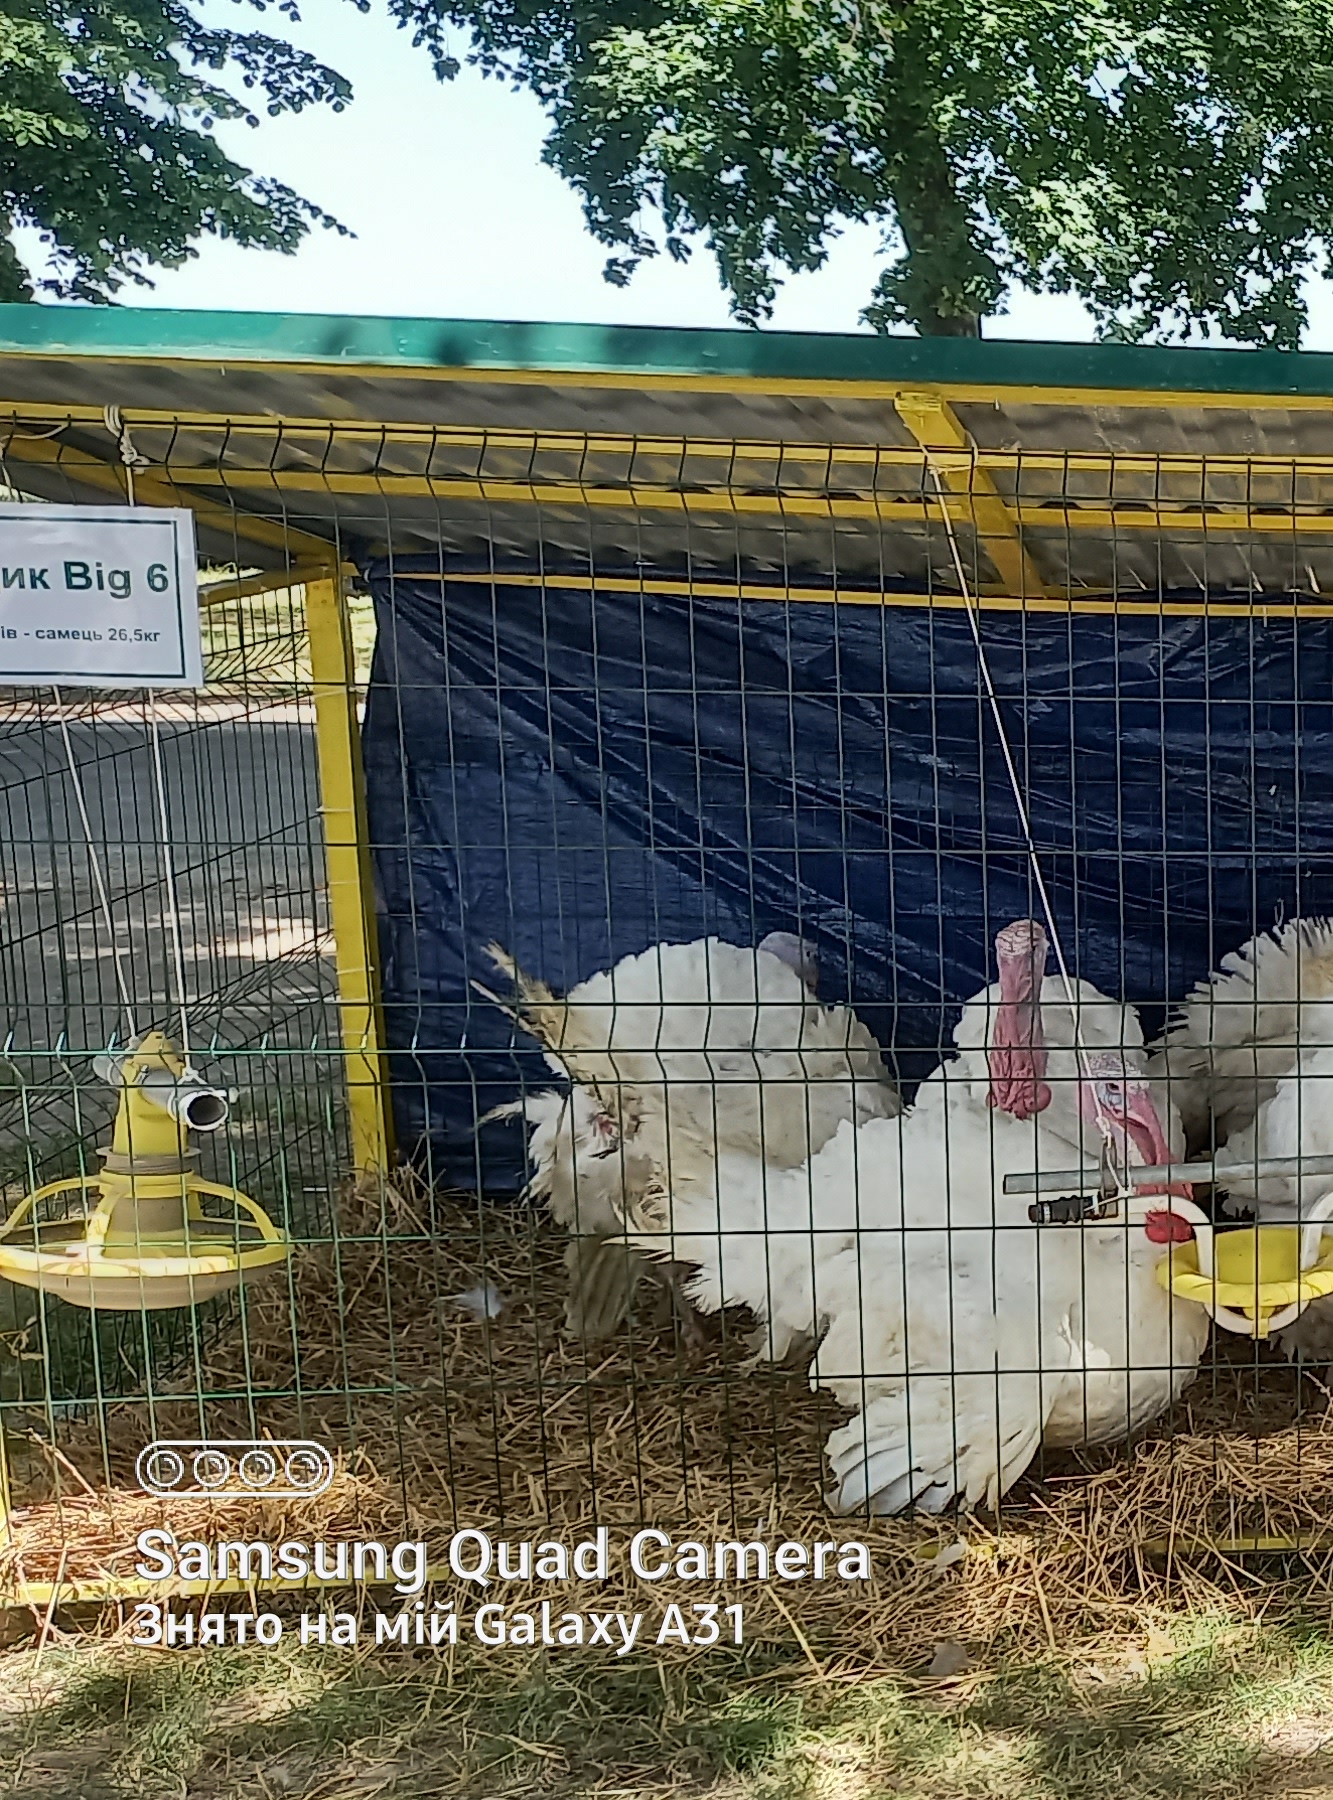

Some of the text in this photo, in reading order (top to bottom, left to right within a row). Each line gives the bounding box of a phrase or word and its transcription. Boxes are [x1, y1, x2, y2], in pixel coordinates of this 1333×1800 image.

[1, 560, 169, 600] ик Big 6
[35, 628, 103, 642] самець
[108, 628, 161, 644] 26,5кг
